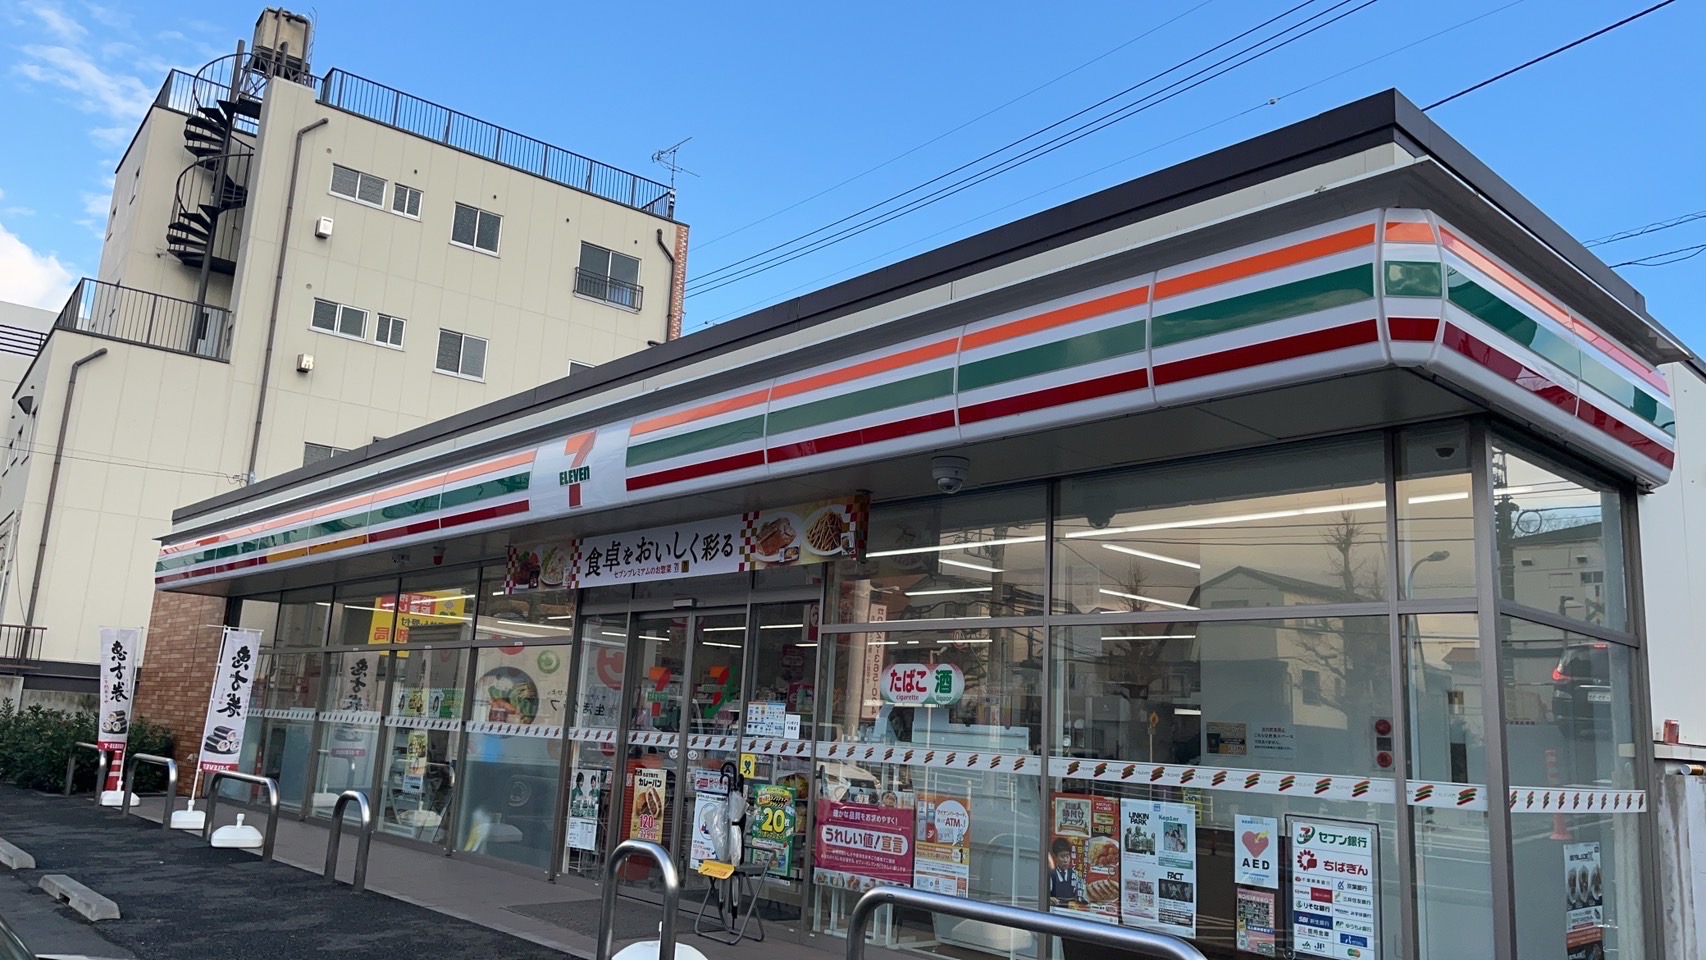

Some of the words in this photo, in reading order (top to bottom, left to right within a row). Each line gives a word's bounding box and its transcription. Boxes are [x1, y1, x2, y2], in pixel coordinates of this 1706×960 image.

[584, 531, 734, 578] 食卓をおいしく彩る
[614, 564, 672, 579] セブンプレミアムのお惣菜
[110, 640, 128, 702] 恵方巻
[889, 669, 927, 693] たばこ
[935, 669, 953, 694] 酒
[638, 778, 662, 788] カレーパン
[640, 814, 654, 828] 120
[1128, 811, 1149, 820] LINKIN
[825, 827, 904, 854] うれしい値!宣言
[1319, 832, 1367, 848] セブン銀行
[1242, 858, 1270, 870] AED
[1323, 860, 1368, 876] ちばぎん
[1167, 872, 1184, 880] FACT
[1303, 902, 1330, 913] りそな銀行
[1310, 918, 1330, 927] 新生銀行
[1345, 923, 1372, 933] ゆうちょ銀行
